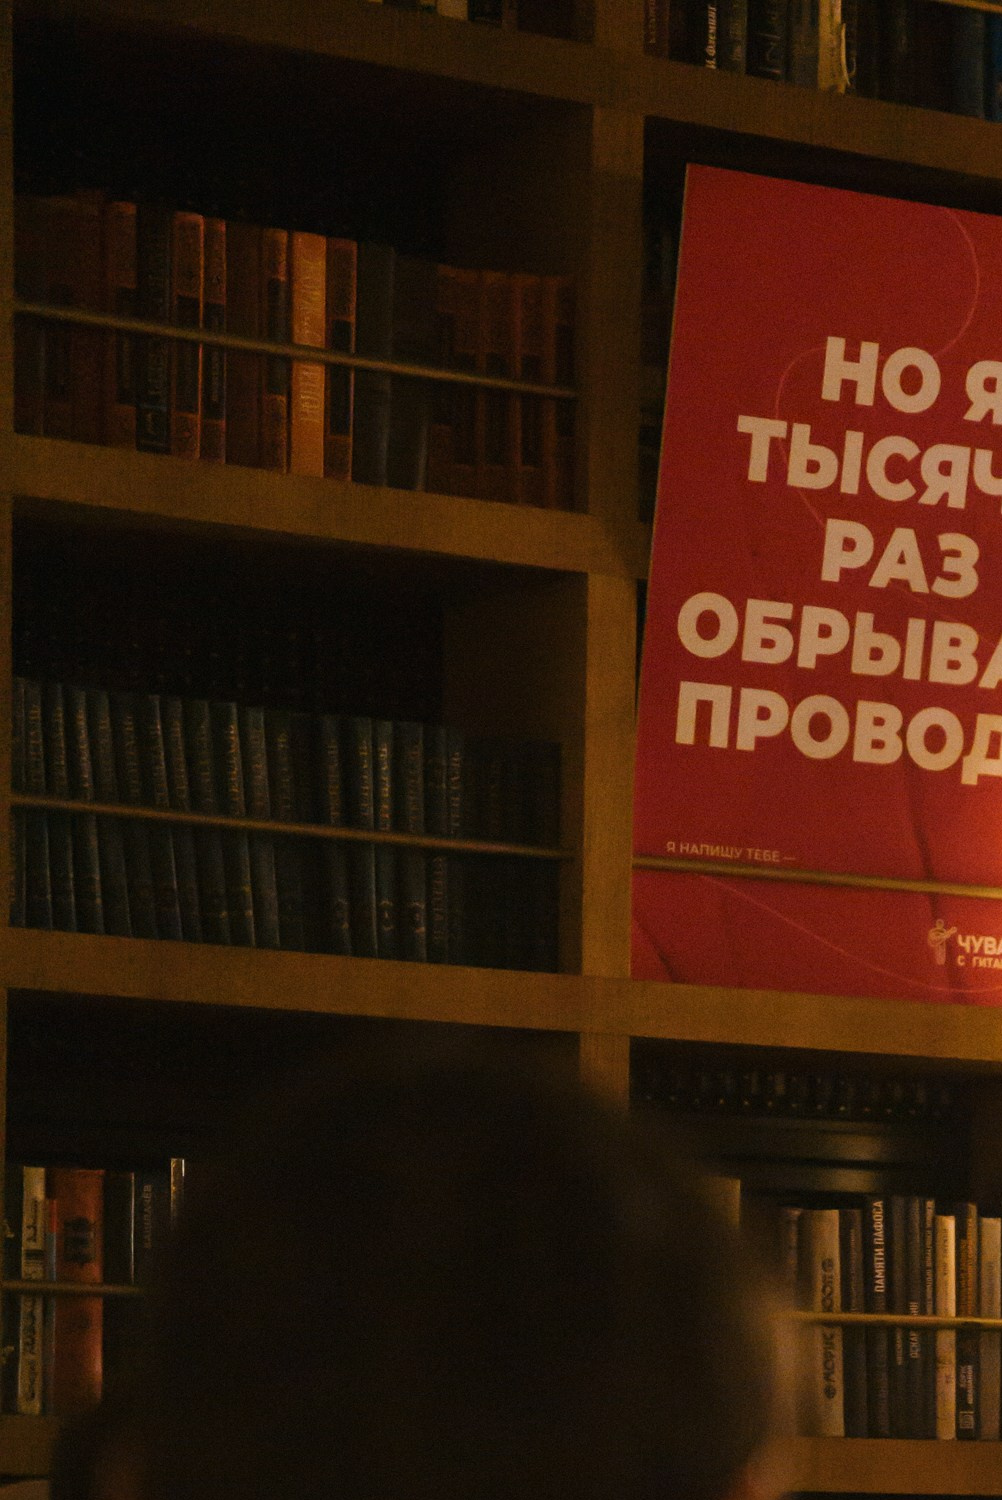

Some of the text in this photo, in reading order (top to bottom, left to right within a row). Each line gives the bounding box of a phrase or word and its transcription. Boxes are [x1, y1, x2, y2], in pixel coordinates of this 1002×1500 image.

[821, 336, 942, 414] НО
[821, 518, 980, 599] РАЗ
[666, 841, 676, 853] Я
[679, 842, 743, 859] НАПИШУ
[747, 848, 781, 863] ТЕБЕ
[957, 955, 965, 966] С
[872, 1200, 884, 1245] ПАФОСА
[874, 1249, 886, 1293] ПАМЯТИ
